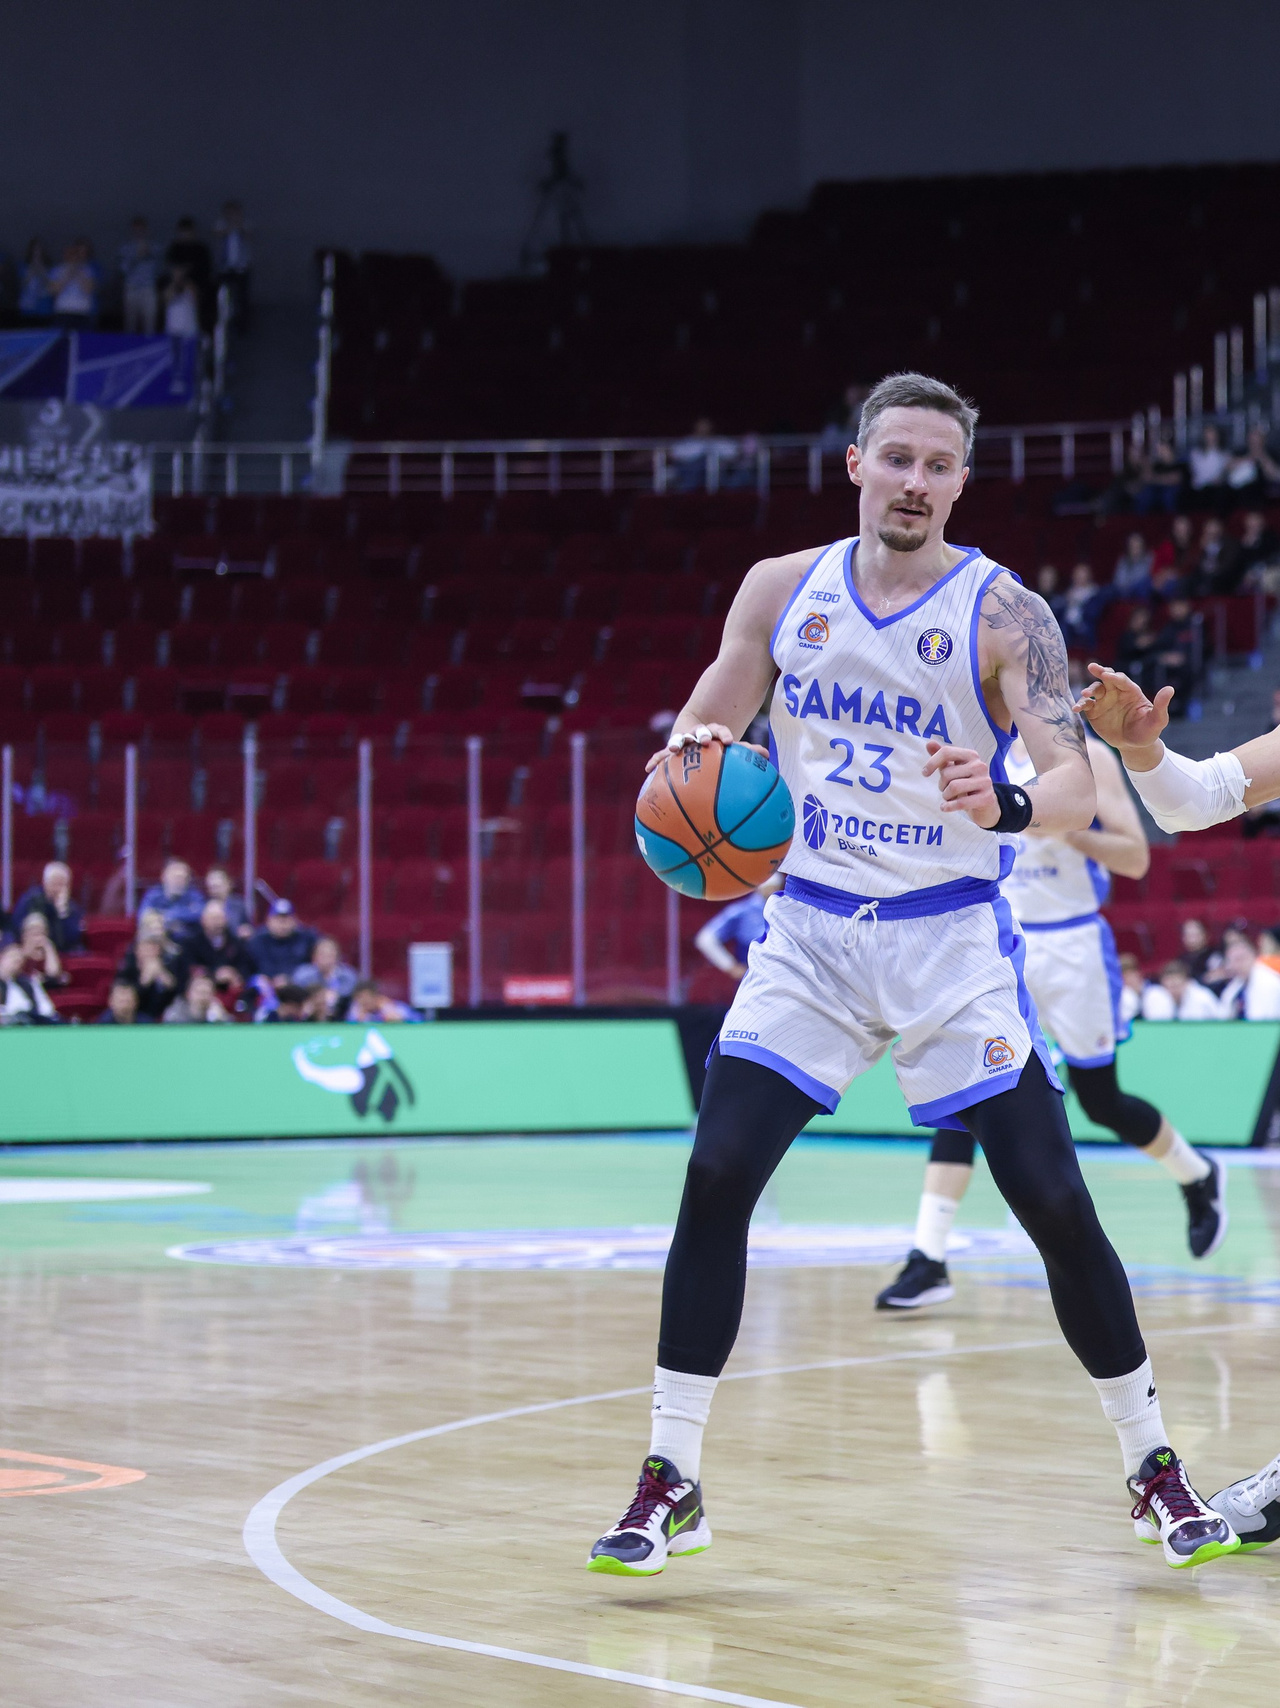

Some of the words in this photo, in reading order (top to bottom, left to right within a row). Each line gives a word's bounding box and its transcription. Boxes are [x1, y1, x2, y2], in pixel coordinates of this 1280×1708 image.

[808, 590, 841, 604] ZEDO
[783, 674, 953, 744] SAMARA
[825, 738, 895, 794] 23
[831, 813, 944, 847] РОССЕТИ
[725, 1030, 760, 1042] ZEDO
